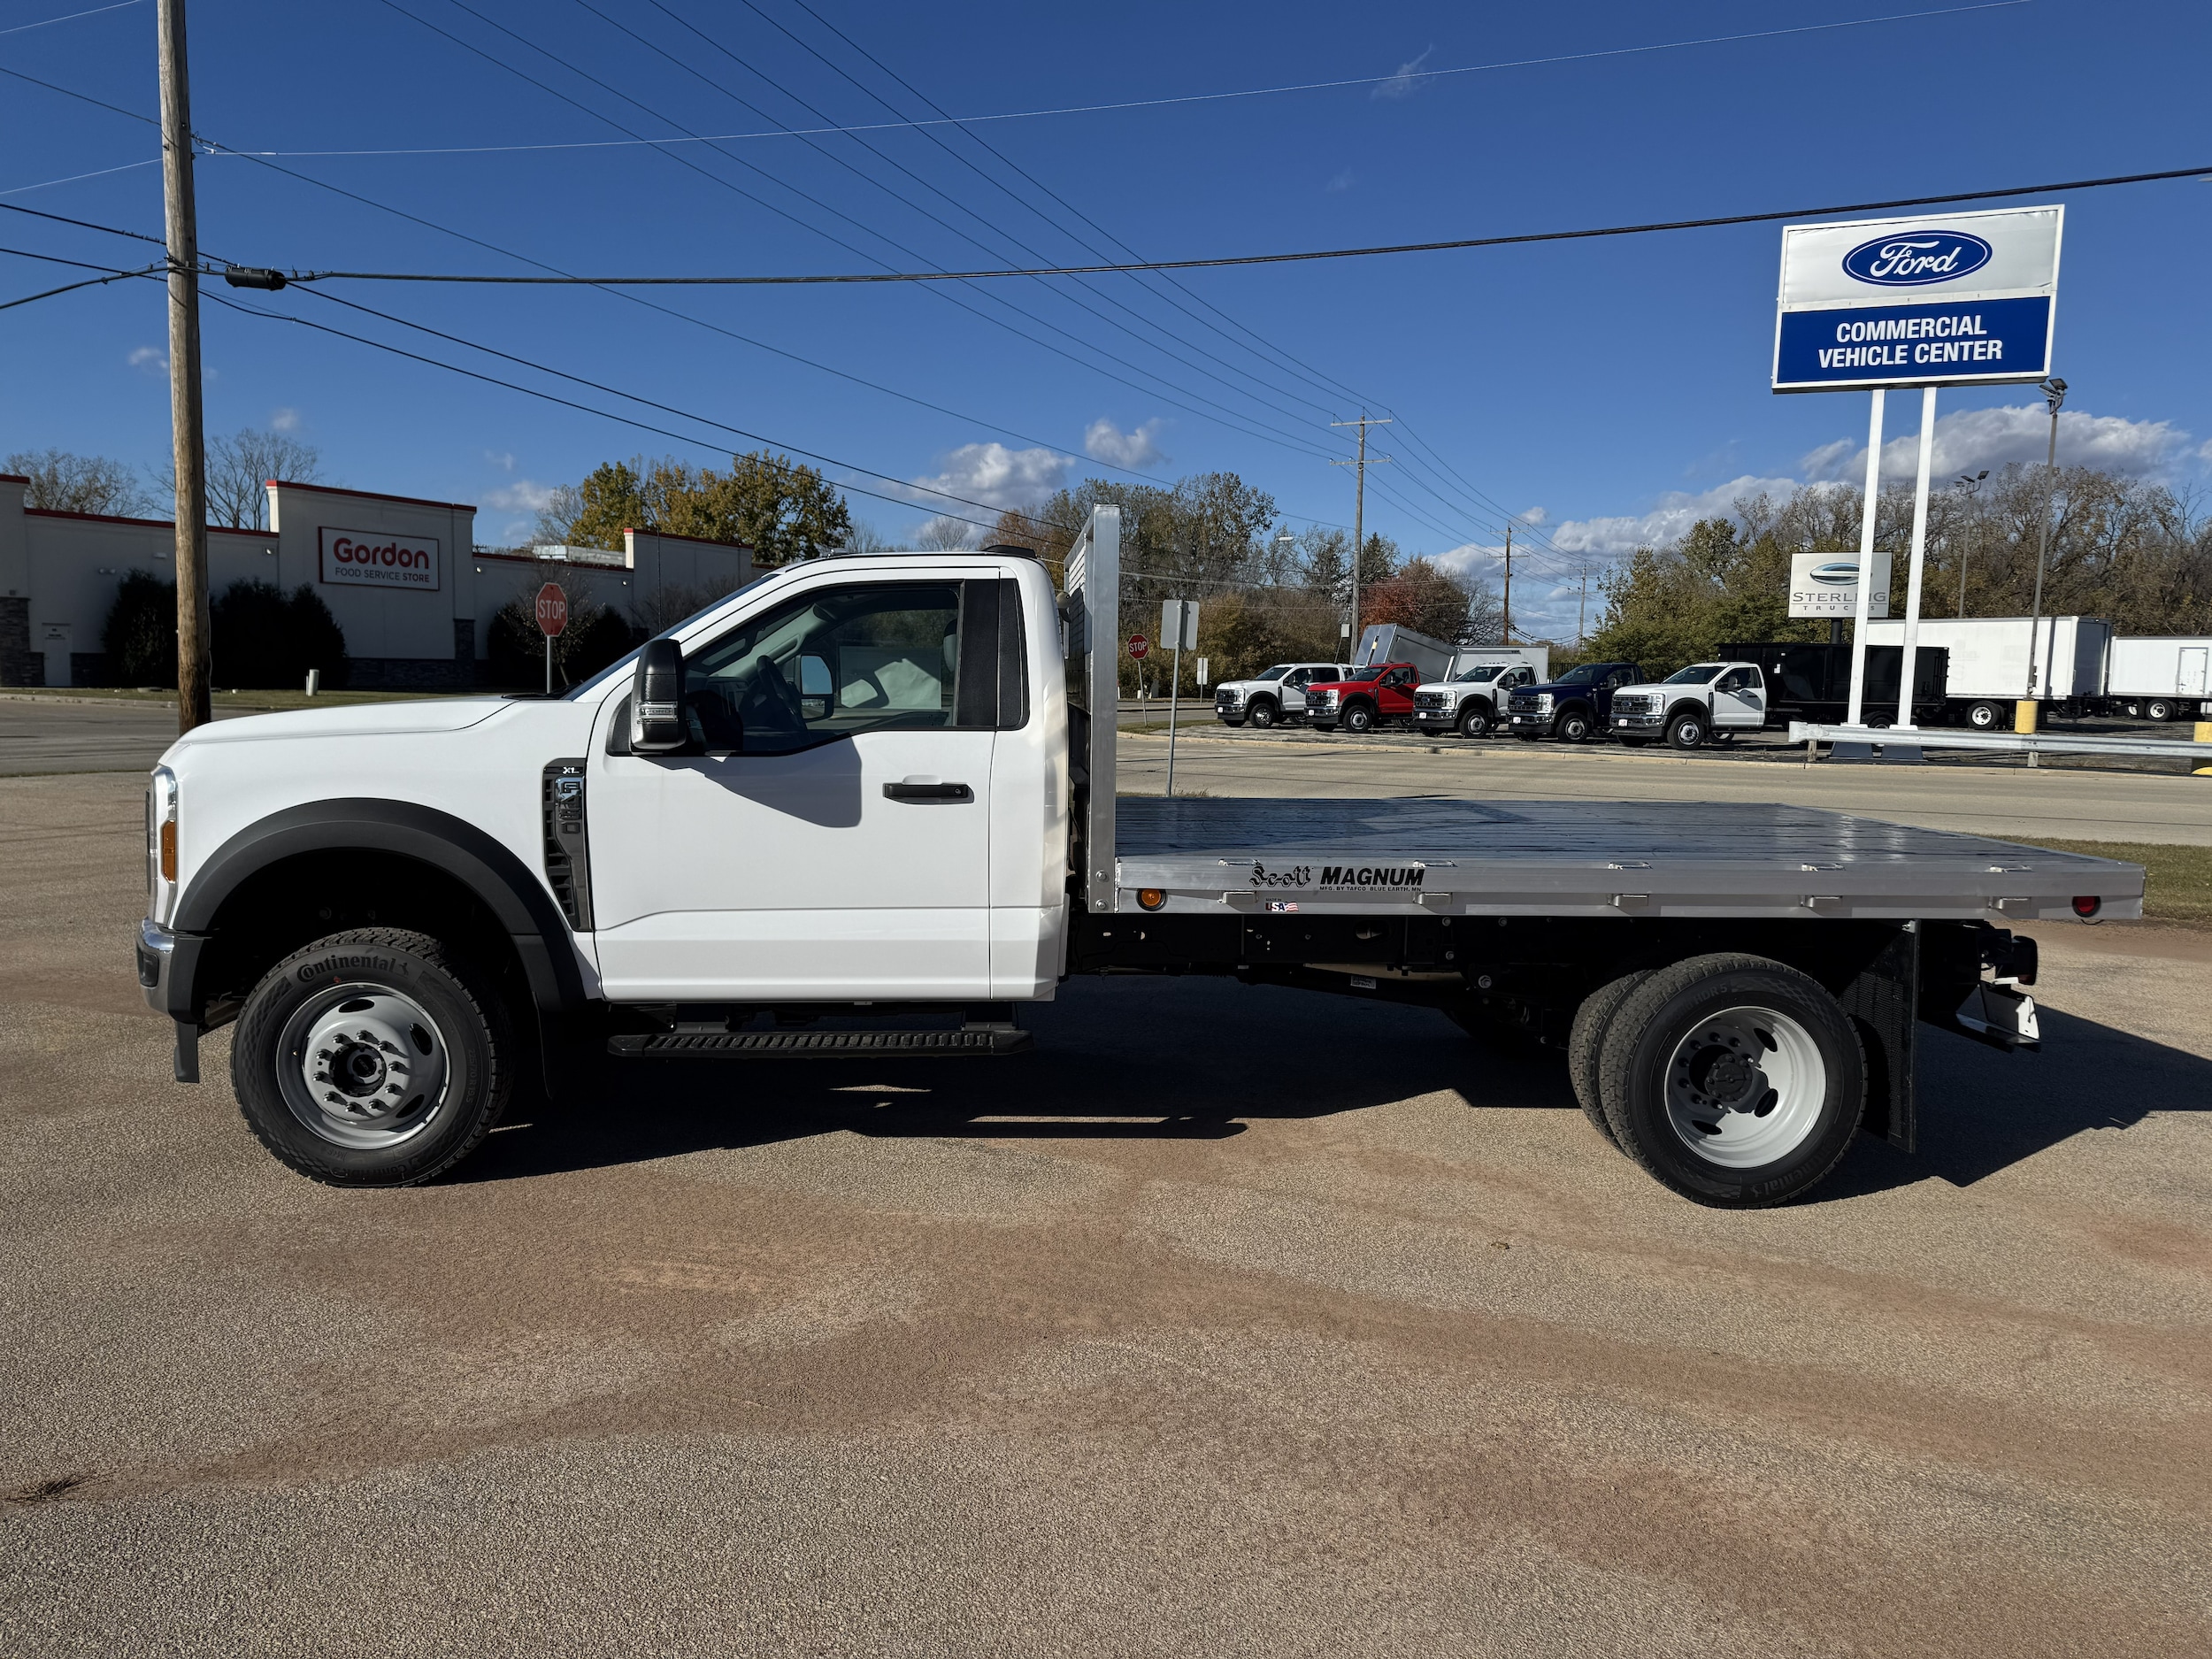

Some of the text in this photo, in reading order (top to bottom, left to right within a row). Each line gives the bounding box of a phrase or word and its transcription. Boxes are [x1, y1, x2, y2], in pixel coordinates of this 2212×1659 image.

[1870, 241, 1962, 278] Ford
[1836, 314, 1987, 343] COMMERCIAL
[1818, 340, 2003, 368] VEHICLE CENTER
[333, 537, 429, 569] Gordon
[335, 567, 430, 583] FOOD SERVICE STORE
[1793, 592, 1886, 603] STERLIG
[539, 599, 565, 619] STOP
[1129, 641, 1147, 652] STOP
[1249, 865, 1425, 887] Scott MAGNUM
[1265, 902, 1286, 911] USA
[296, 954, 396, 983] Continental
